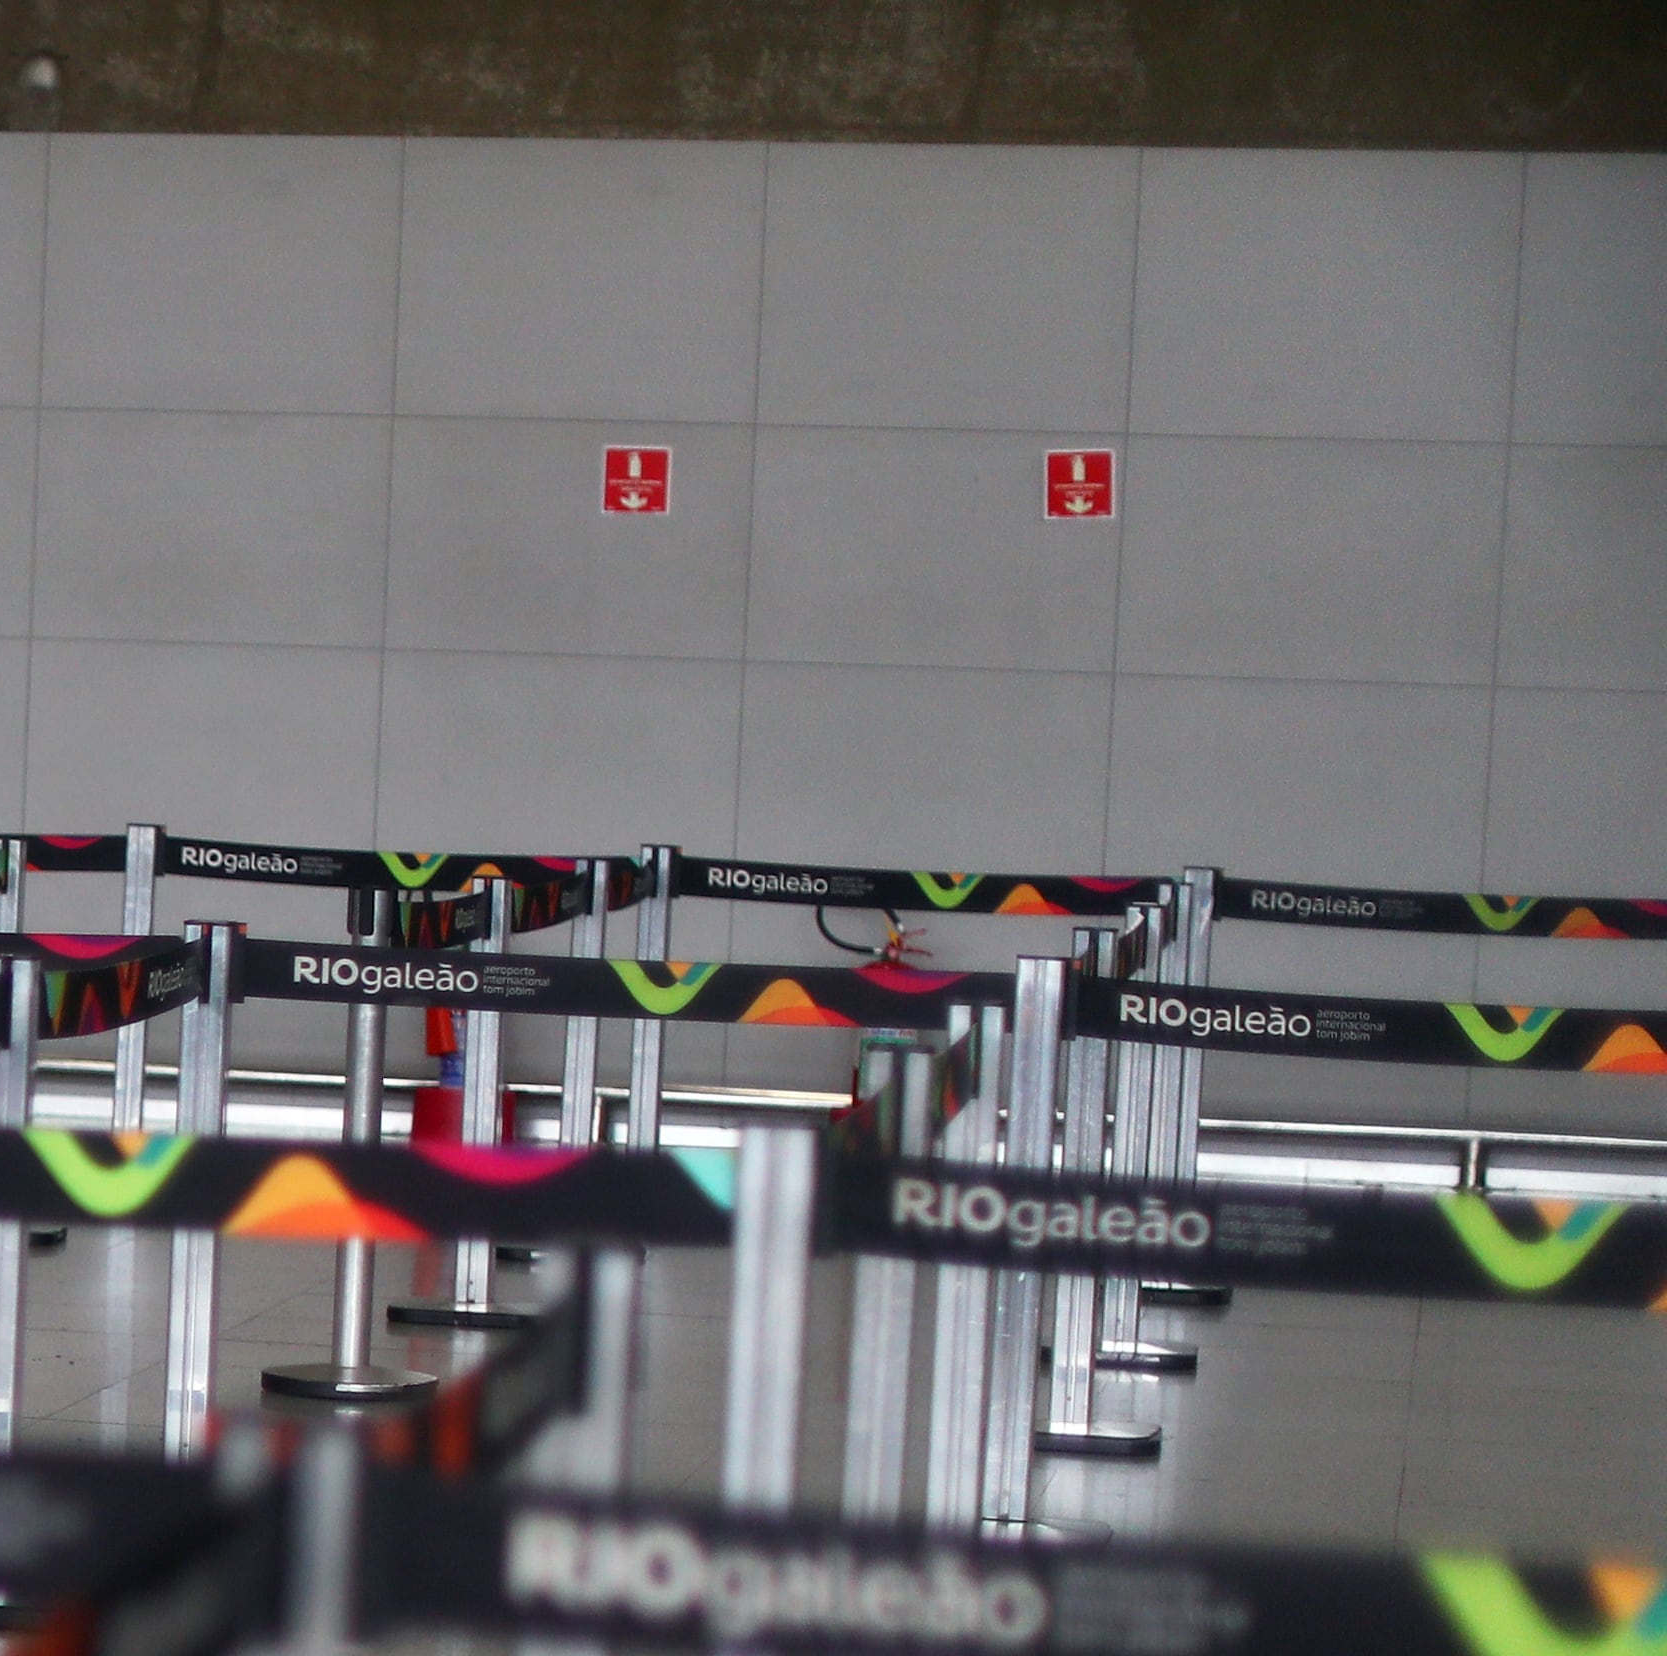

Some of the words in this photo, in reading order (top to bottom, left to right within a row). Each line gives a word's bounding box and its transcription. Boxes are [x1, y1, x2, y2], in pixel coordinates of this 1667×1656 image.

[181, 846, 298, 875] RIOgaleão
[708, 867, 828, 895] RIOgaleão
[1251, 889, 1376, 916] RIOgaleão
[293, 956, 479, 994] RIOgaleão
[1120, 994, 1312, 1036] RIOgaleão
[891, 1178, 1211, 1248] RIOgaleão
